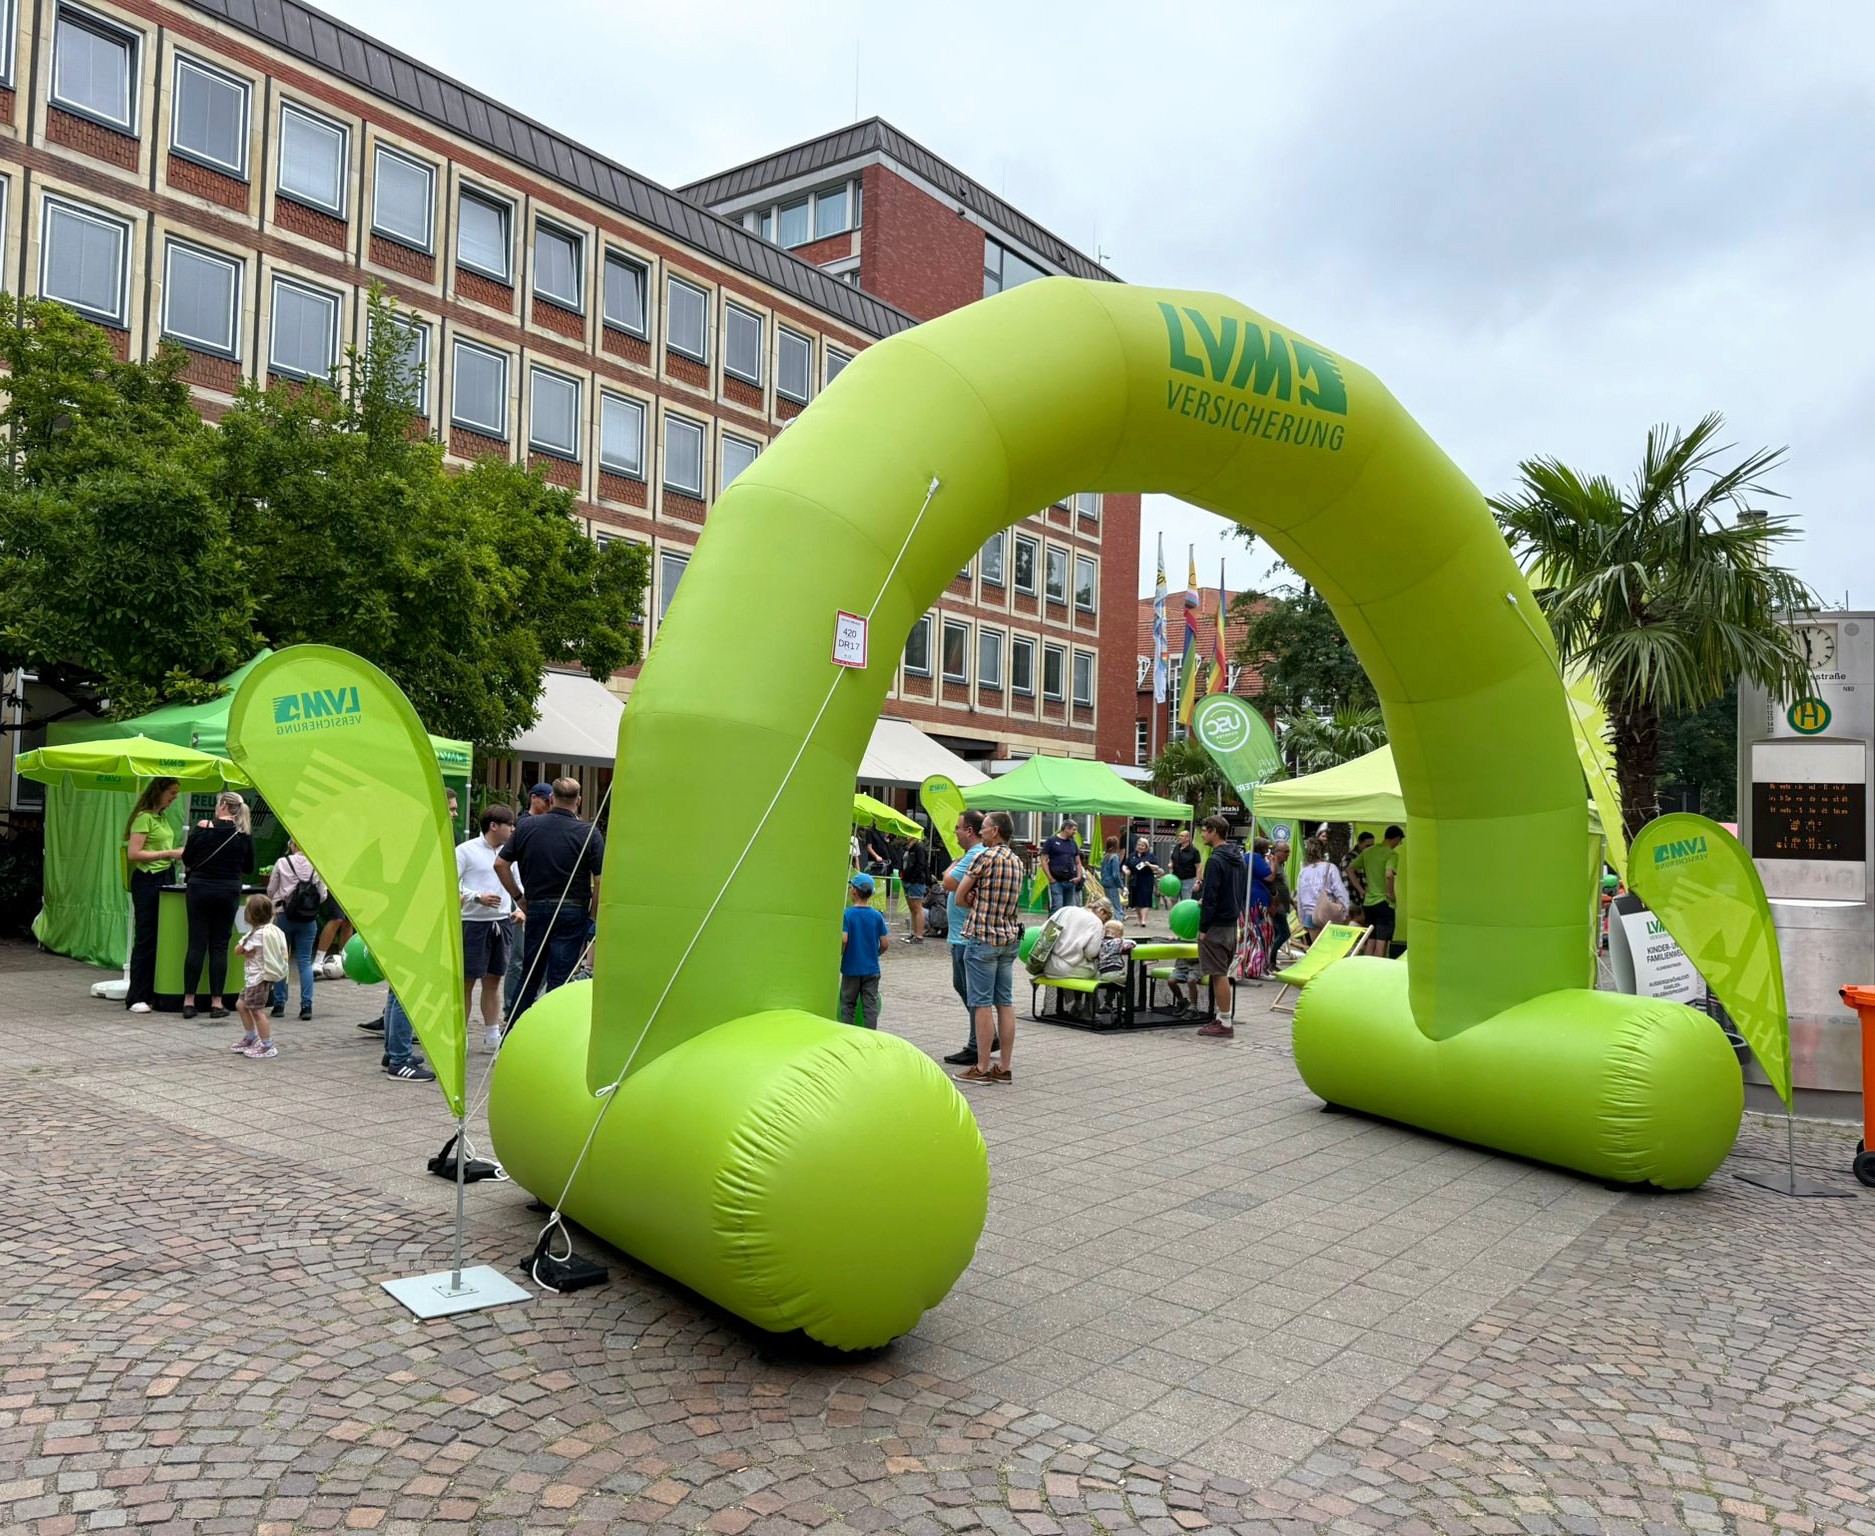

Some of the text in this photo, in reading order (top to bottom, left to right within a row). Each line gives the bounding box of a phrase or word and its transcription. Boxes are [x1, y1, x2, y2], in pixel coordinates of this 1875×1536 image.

[1157, 301, 1293, 402] LVM
[1167, 380, 1346, 452] VERSICHERUNG
[843, 628, 857, 639] 420
[838, 639, 860, 651] DR17
[1647, 949, 1684, 962] FAMILIENWEL
